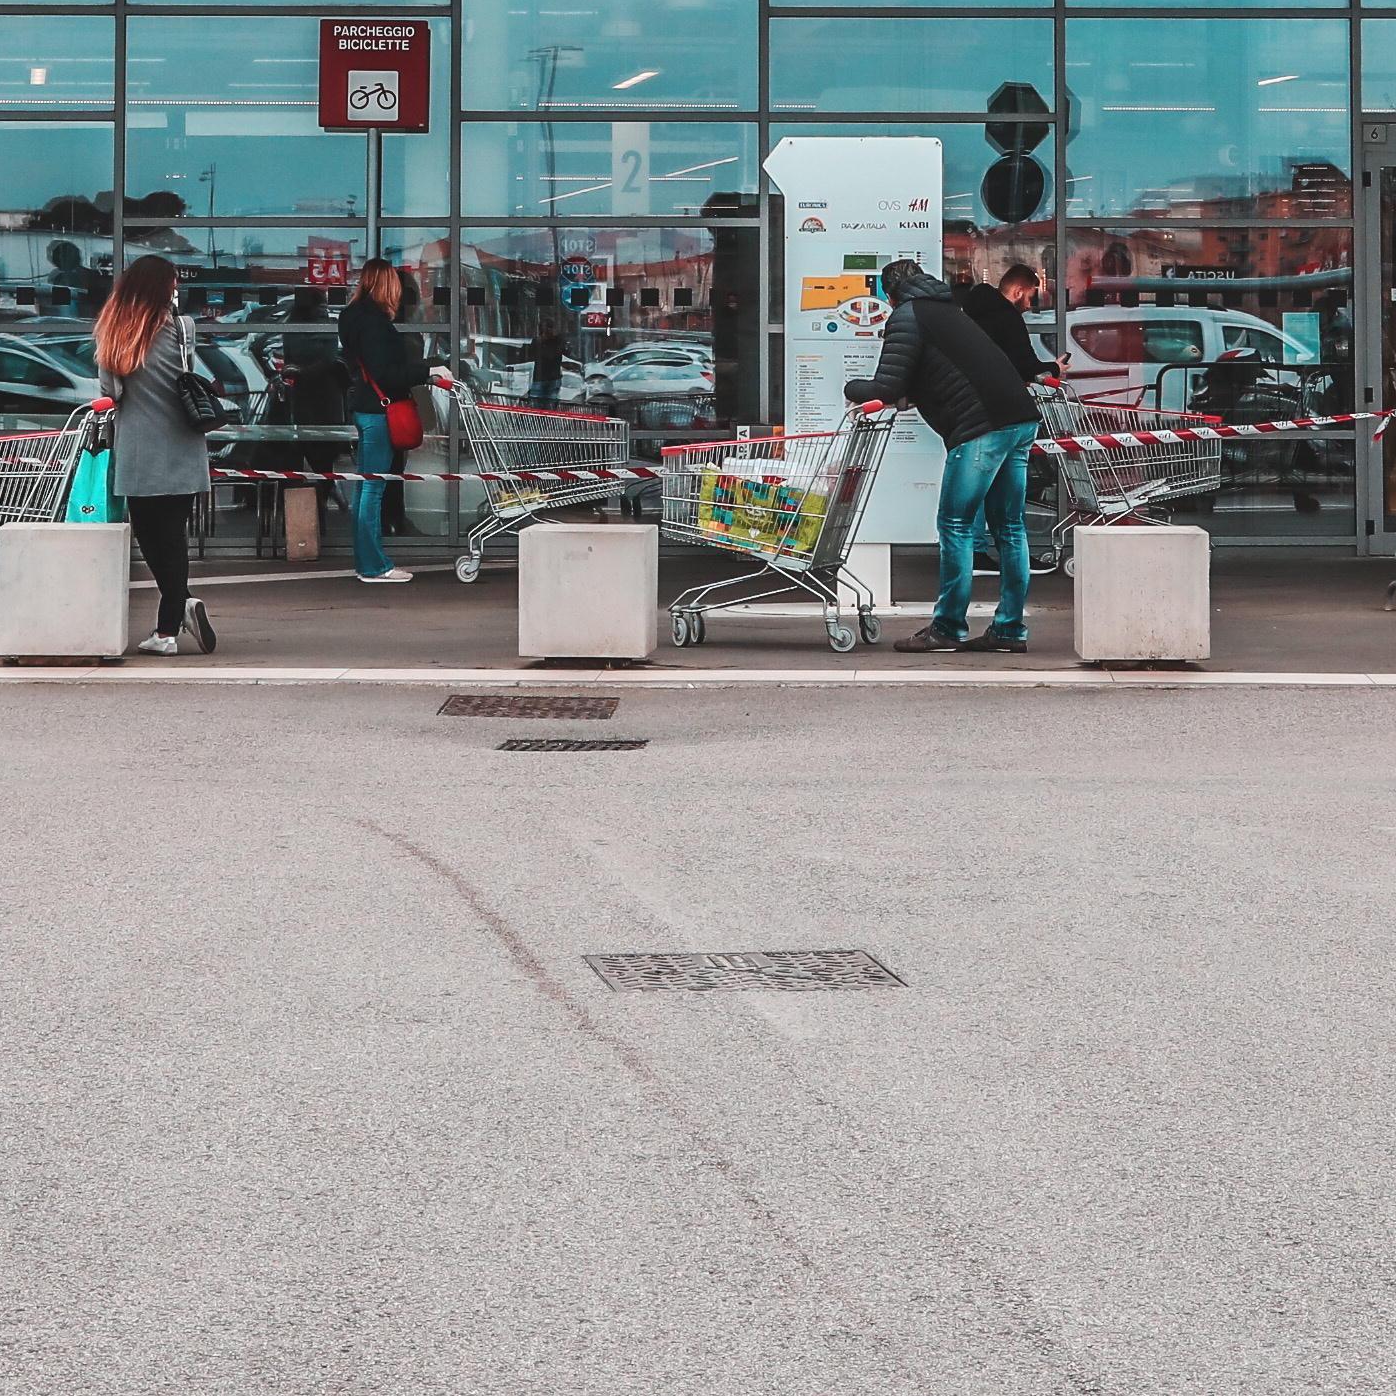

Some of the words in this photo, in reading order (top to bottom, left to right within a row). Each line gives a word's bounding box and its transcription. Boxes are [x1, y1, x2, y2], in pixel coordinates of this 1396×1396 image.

[333, 25, 415, 37] PARCHEGGIO
[338, 39, 410, 50] BICICLETTE
[1370, 127, 1379, 140] 6
[621, 150, 642, 193] 2
[878, 200, 901, 211] OVS
[899, 221, 929, 229] KIABI
